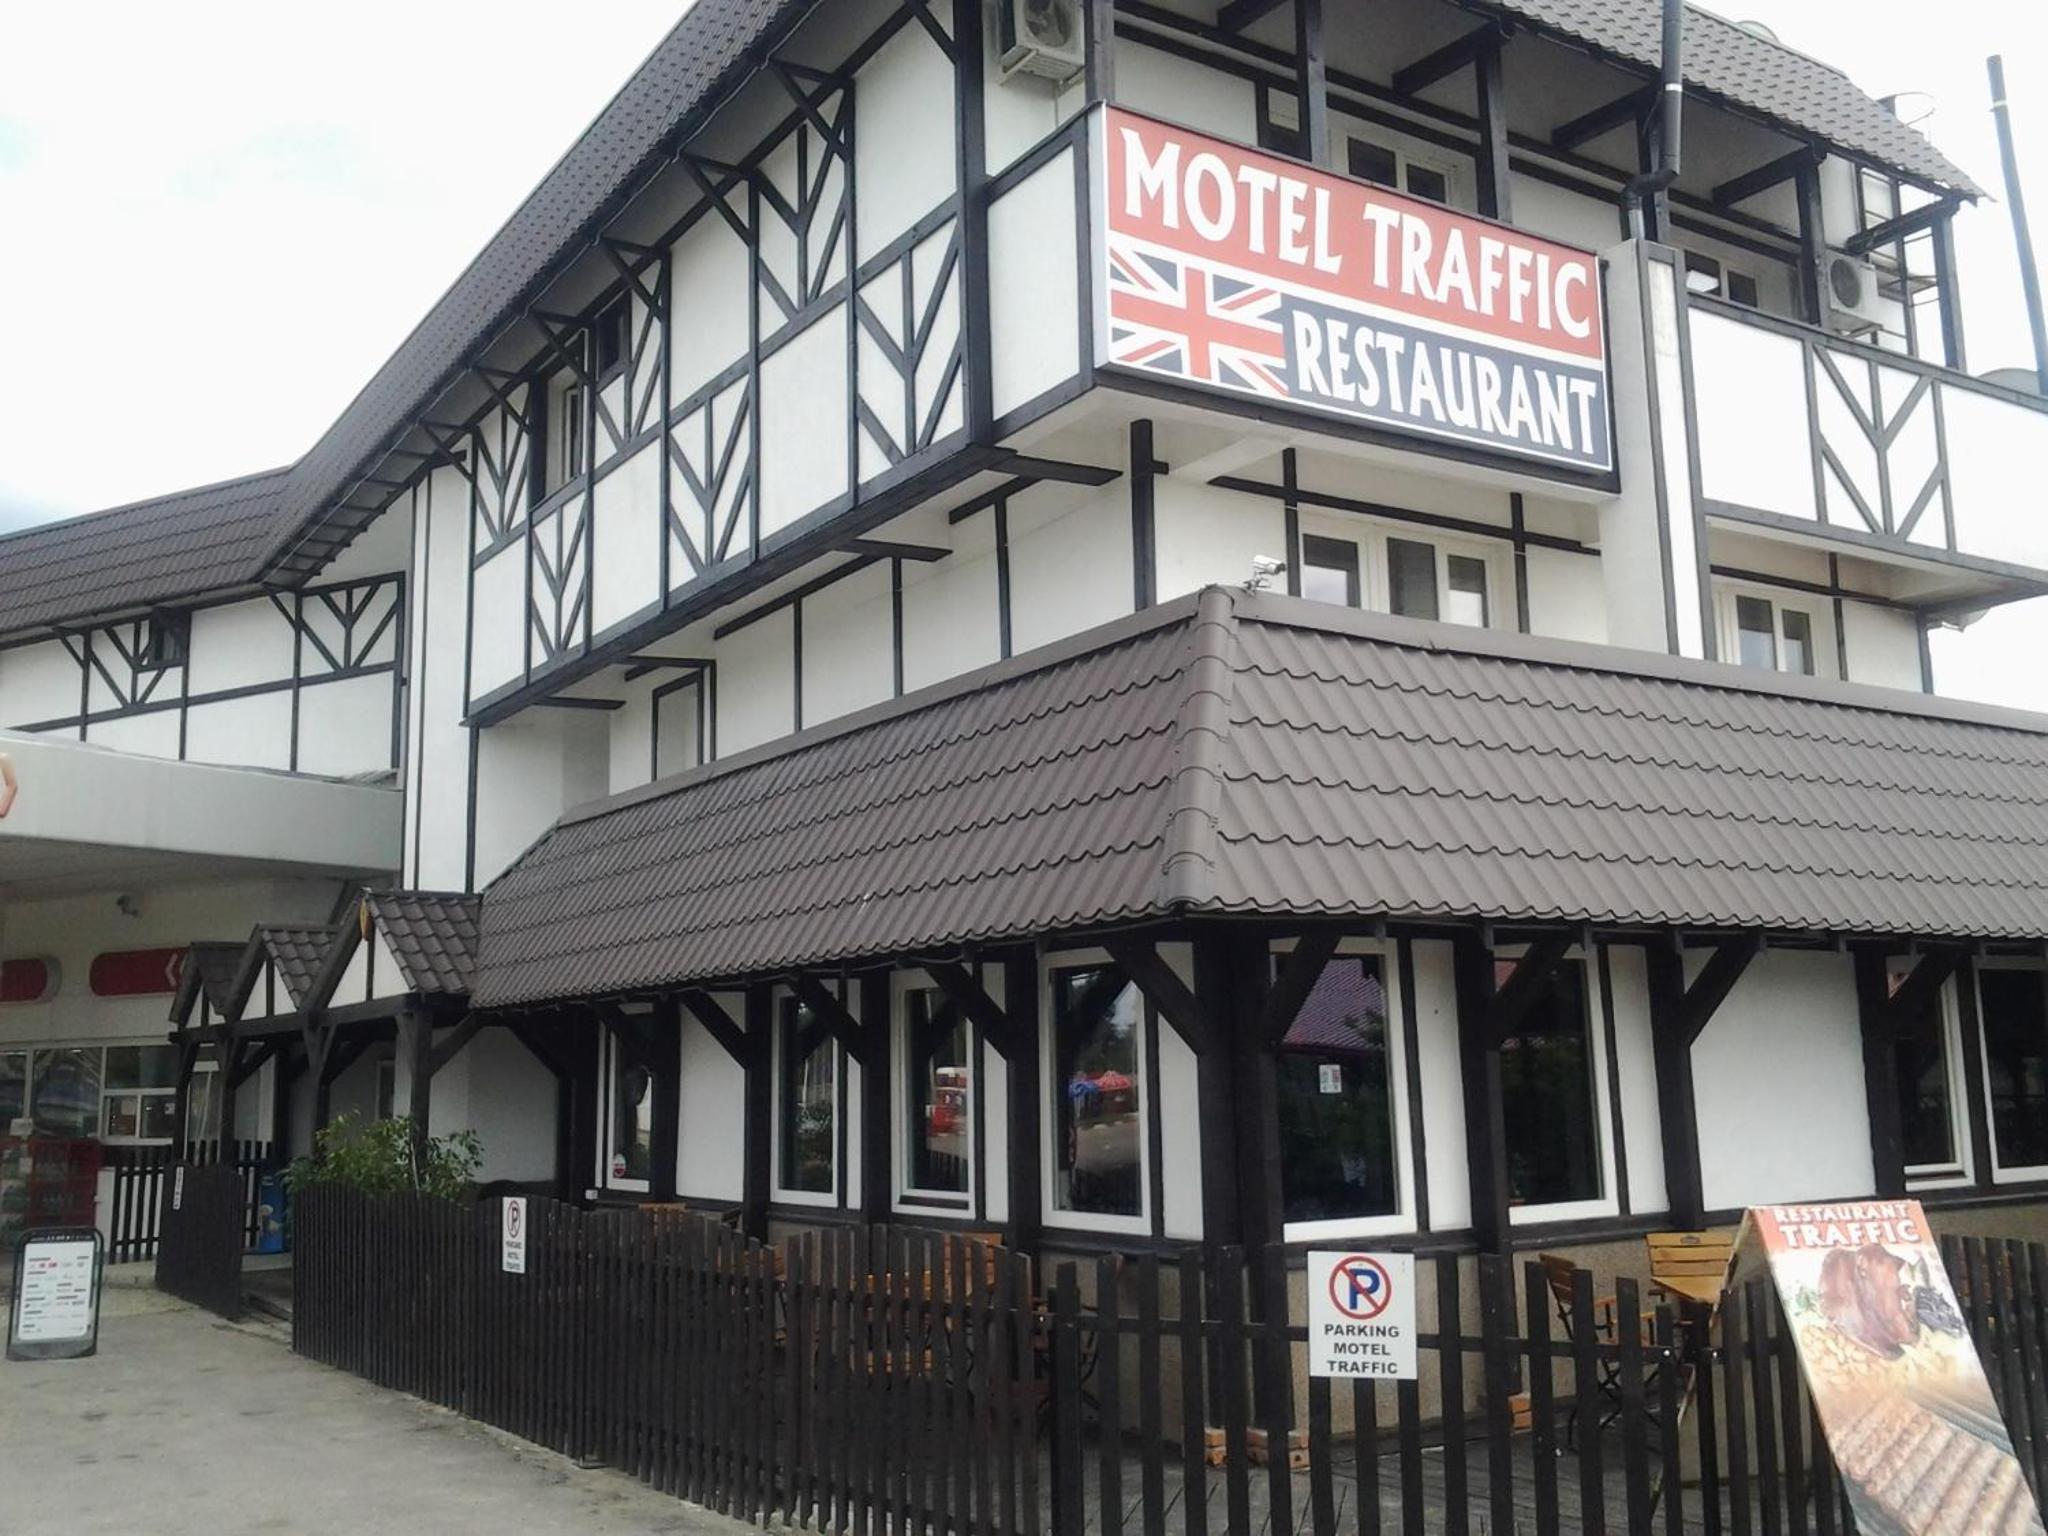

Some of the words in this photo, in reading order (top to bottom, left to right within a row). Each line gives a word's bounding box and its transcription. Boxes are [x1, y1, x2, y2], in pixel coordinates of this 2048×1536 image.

[1120, 127, 1342, 275] MOTEL
[1363, 203, 1591, 339] TRAFFIC
[1292, 310, 1597, 454] RESTAURANT
[1773, 1203, 1909, 1223] RESTAURANT
[1779, 1220, 1921, 1249] TRAFFIC
[1325, 1324, 1400, 1338] PARKING
[1333, 1343, 1391, 1356] MOTEL
[1327, 1360, 1398, 1374] TRAFFIC
